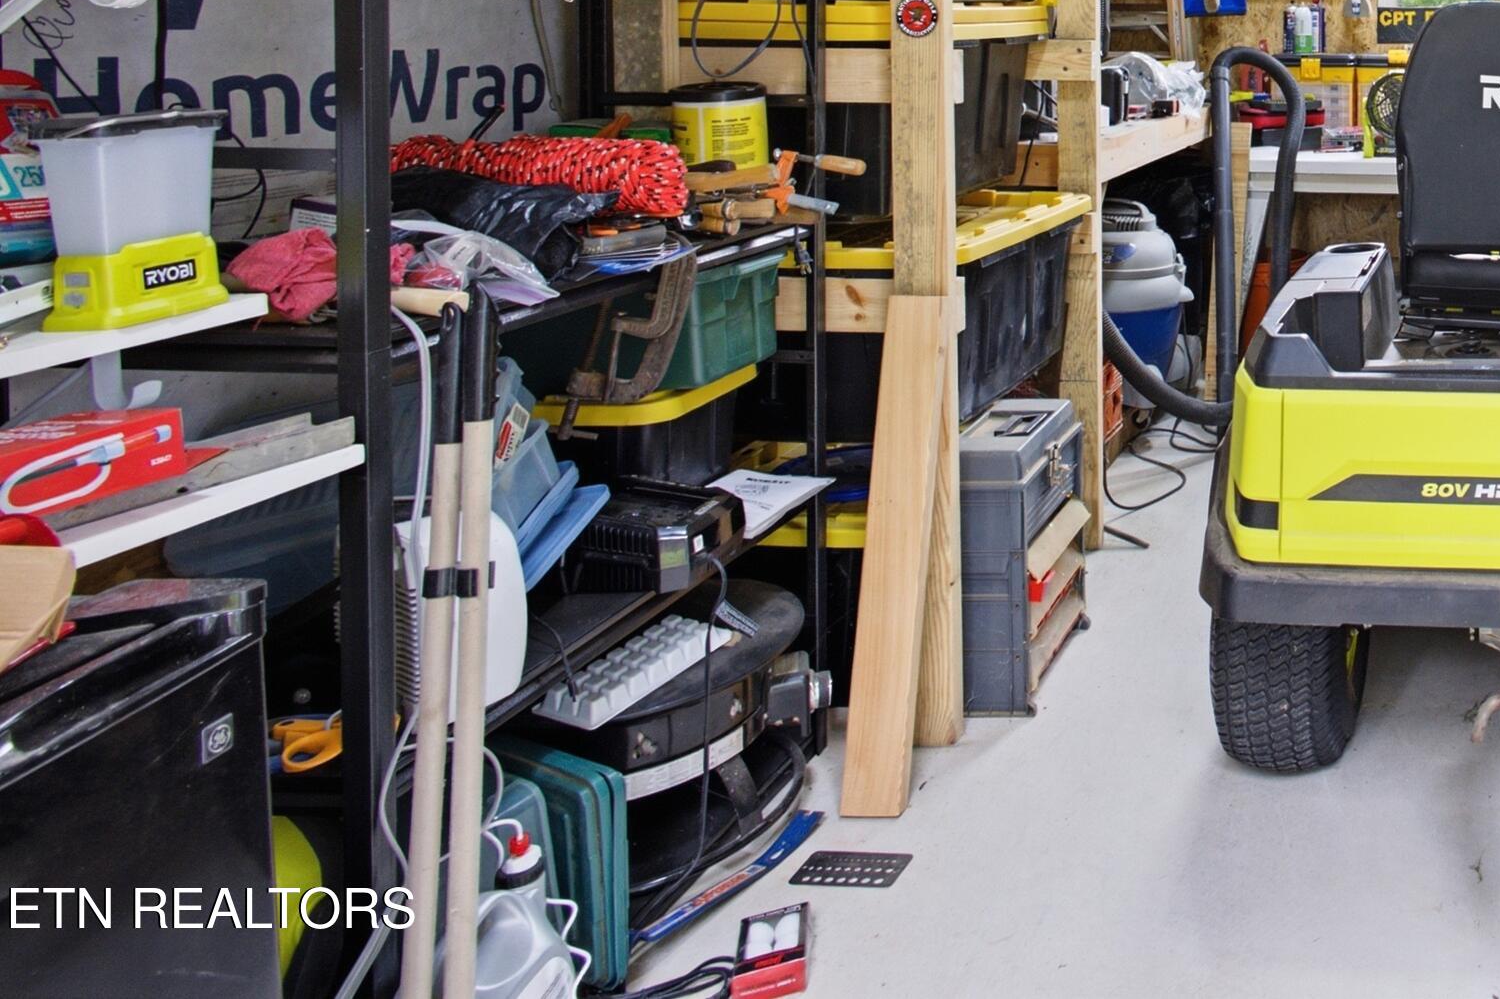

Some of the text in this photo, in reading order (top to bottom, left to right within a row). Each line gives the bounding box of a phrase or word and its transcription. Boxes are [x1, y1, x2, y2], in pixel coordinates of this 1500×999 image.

[1379, 10, 1416, 27] CPT
[144, 261, 194, 286] RYOBI
[1421, 482, 1470, 498] 80V
